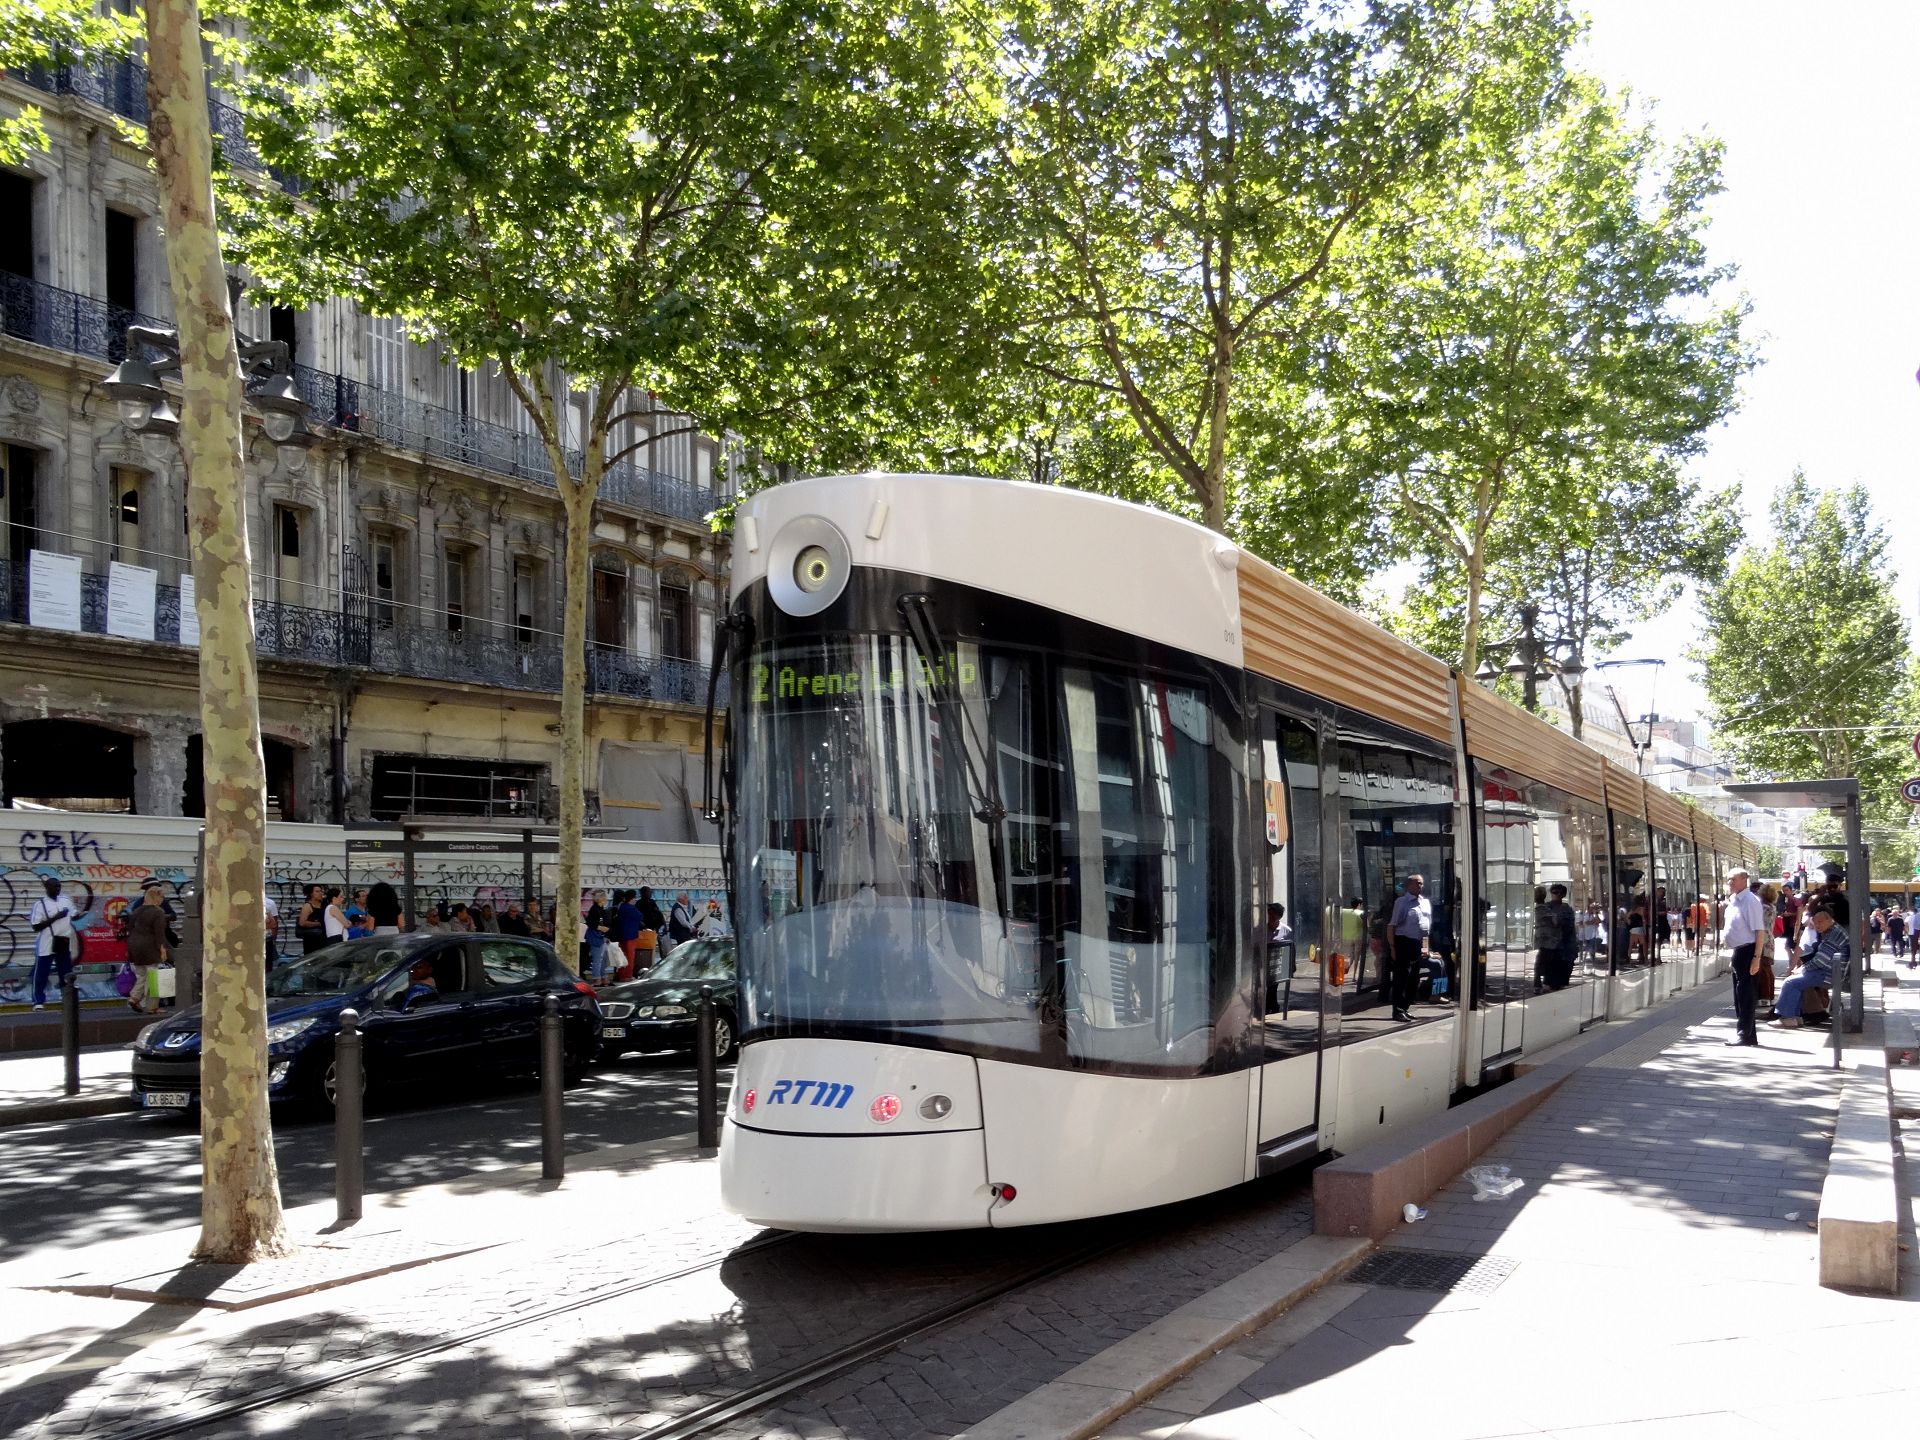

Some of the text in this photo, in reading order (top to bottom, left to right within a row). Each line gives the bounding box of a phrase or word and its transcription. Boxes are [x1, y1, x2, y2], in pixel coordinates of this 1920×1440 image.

[752, 664, 769, 702] 2
[779, 666, 859, 698] Arenc
[475, 843, 499, 851] Capucins
[766, 1080, 854, 1109] RTM
